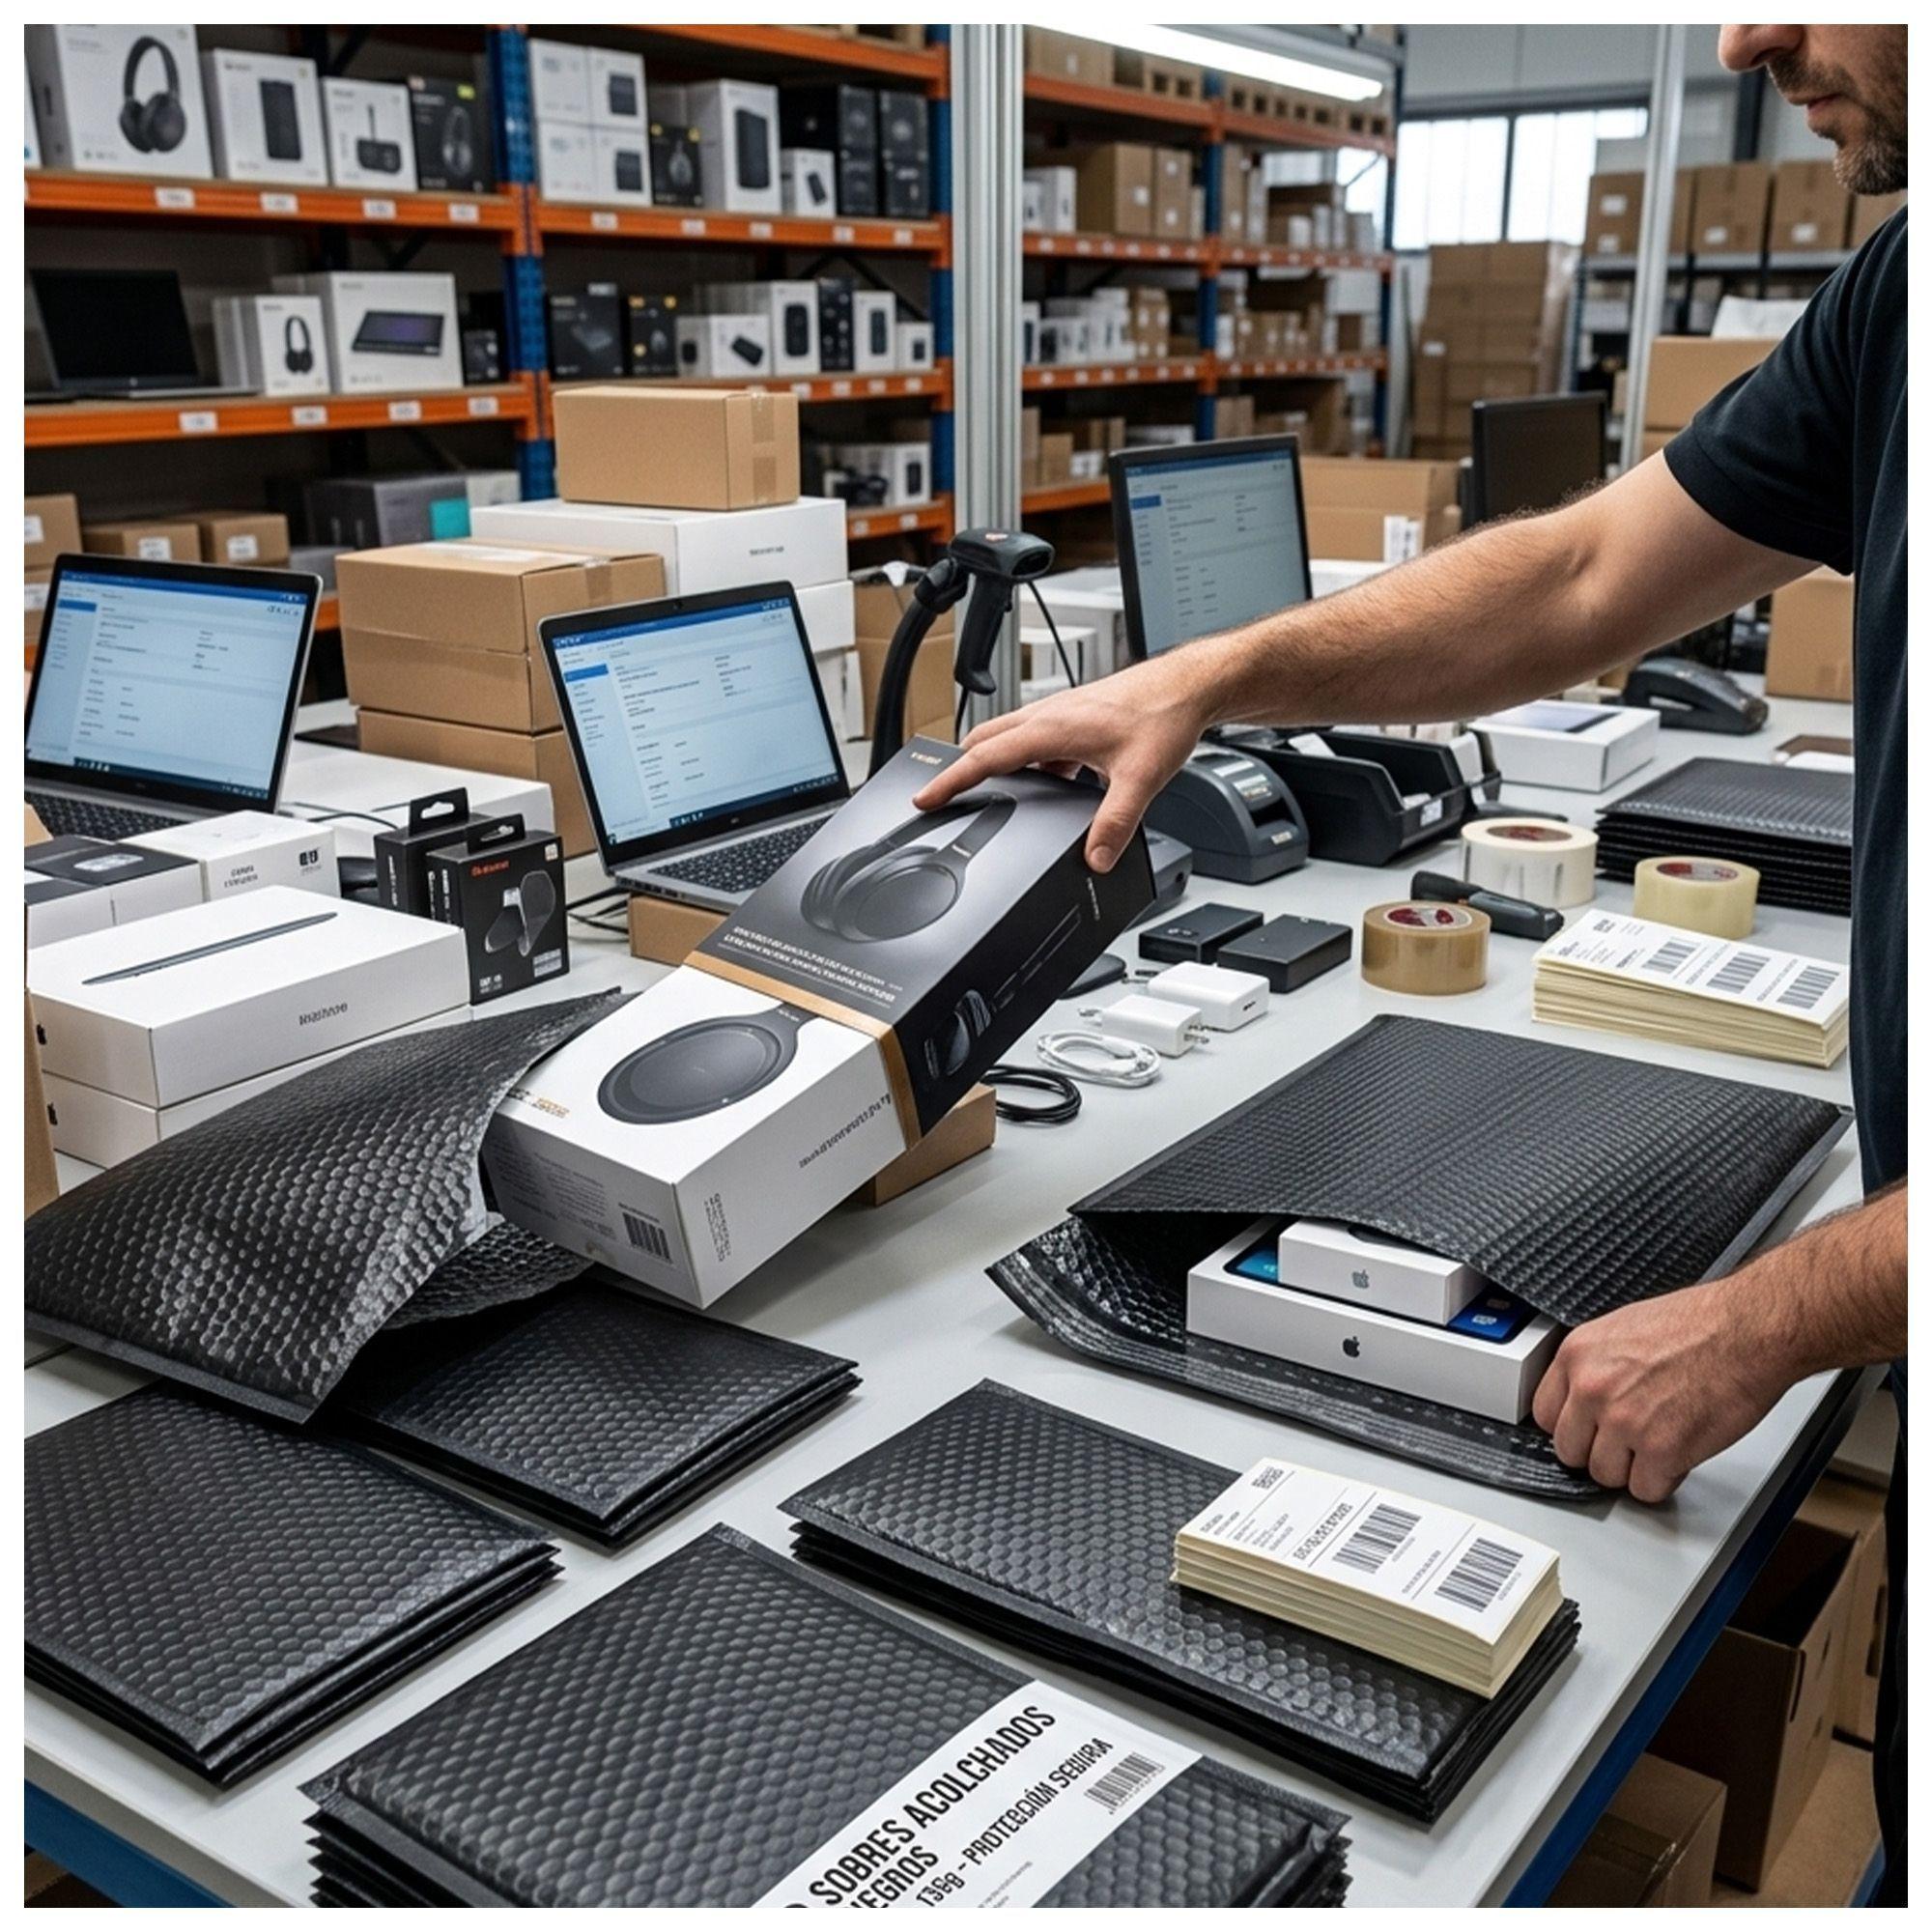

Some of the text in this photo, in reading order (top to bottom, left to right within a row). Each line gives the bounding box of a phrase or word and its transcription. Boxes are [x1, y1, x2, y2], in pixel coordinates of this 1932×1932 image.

[809, 1819, 916, 1906] SOBRES
[902, 1706, 1056, 1829] ACOLCHADOS
[850, 1845, 940, 1908] EGROS
